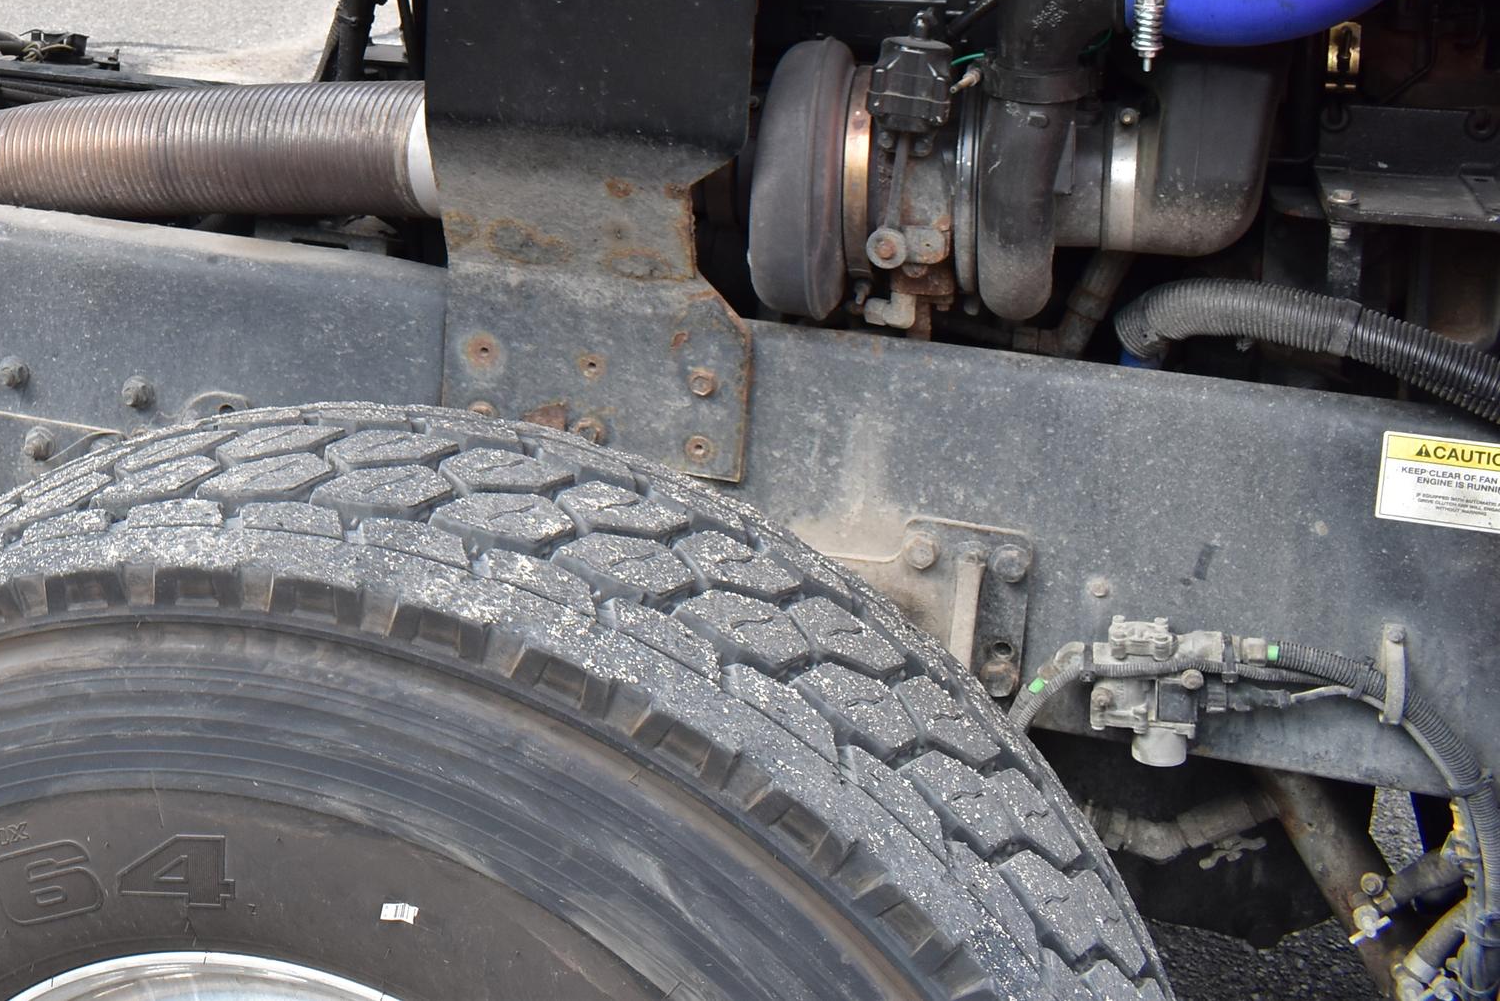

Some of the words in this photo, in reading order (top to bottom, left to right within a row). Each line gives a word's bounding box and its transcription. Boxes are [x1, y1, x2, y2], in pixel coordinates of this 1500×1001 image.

[1433, 446, 1500, 466] CAUTIO
[1401, 466, 1427, 476] KEEP
[1429, 470, 1461, 480] CLEAR
[1463, 474, 1477, 482] OF
[1479, 476, 1498, 485] FAN
[1417, 477, 1453, 488] ENGINE
[1455, 481, 1465, 489] IS
